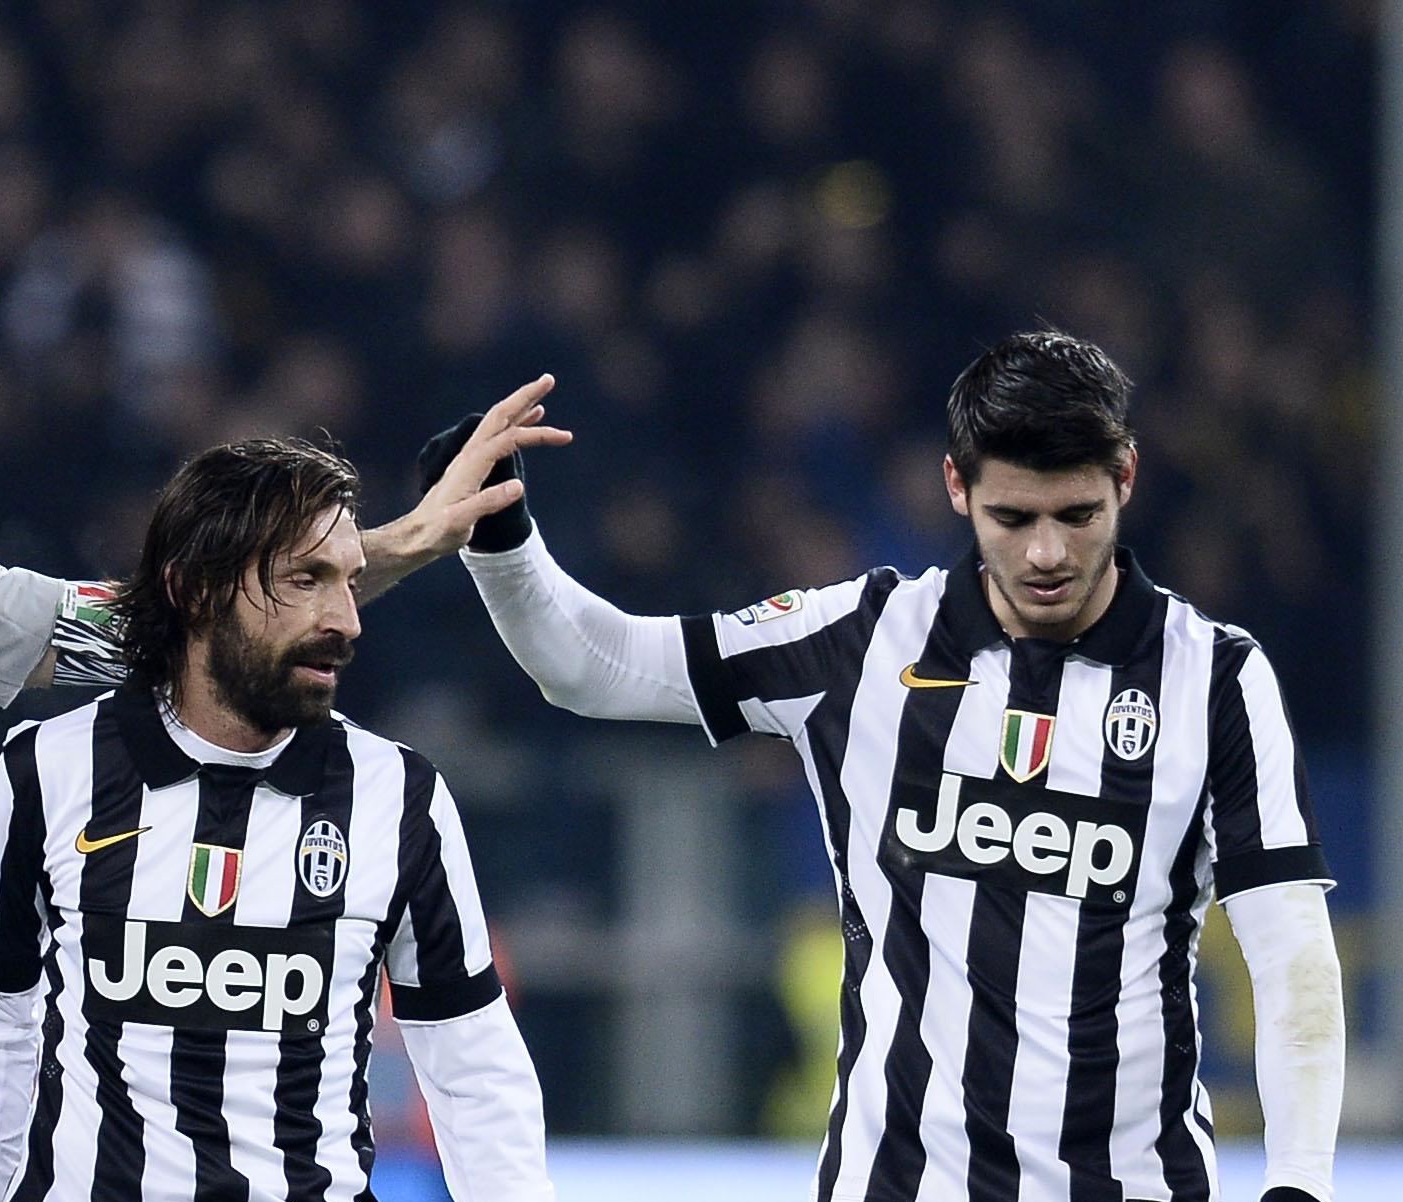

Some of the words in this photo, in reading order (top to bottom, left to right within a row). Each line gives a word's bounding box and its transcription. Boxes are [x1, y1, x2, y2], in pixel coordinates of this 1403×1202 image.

[1111, 705, 1154, 719] JUVENTUS
[304, 837, 344, 854] JUVENTUS
[895, 773, 1134, 898] Jeep
[88, 920, 324, 1031] Jeep
